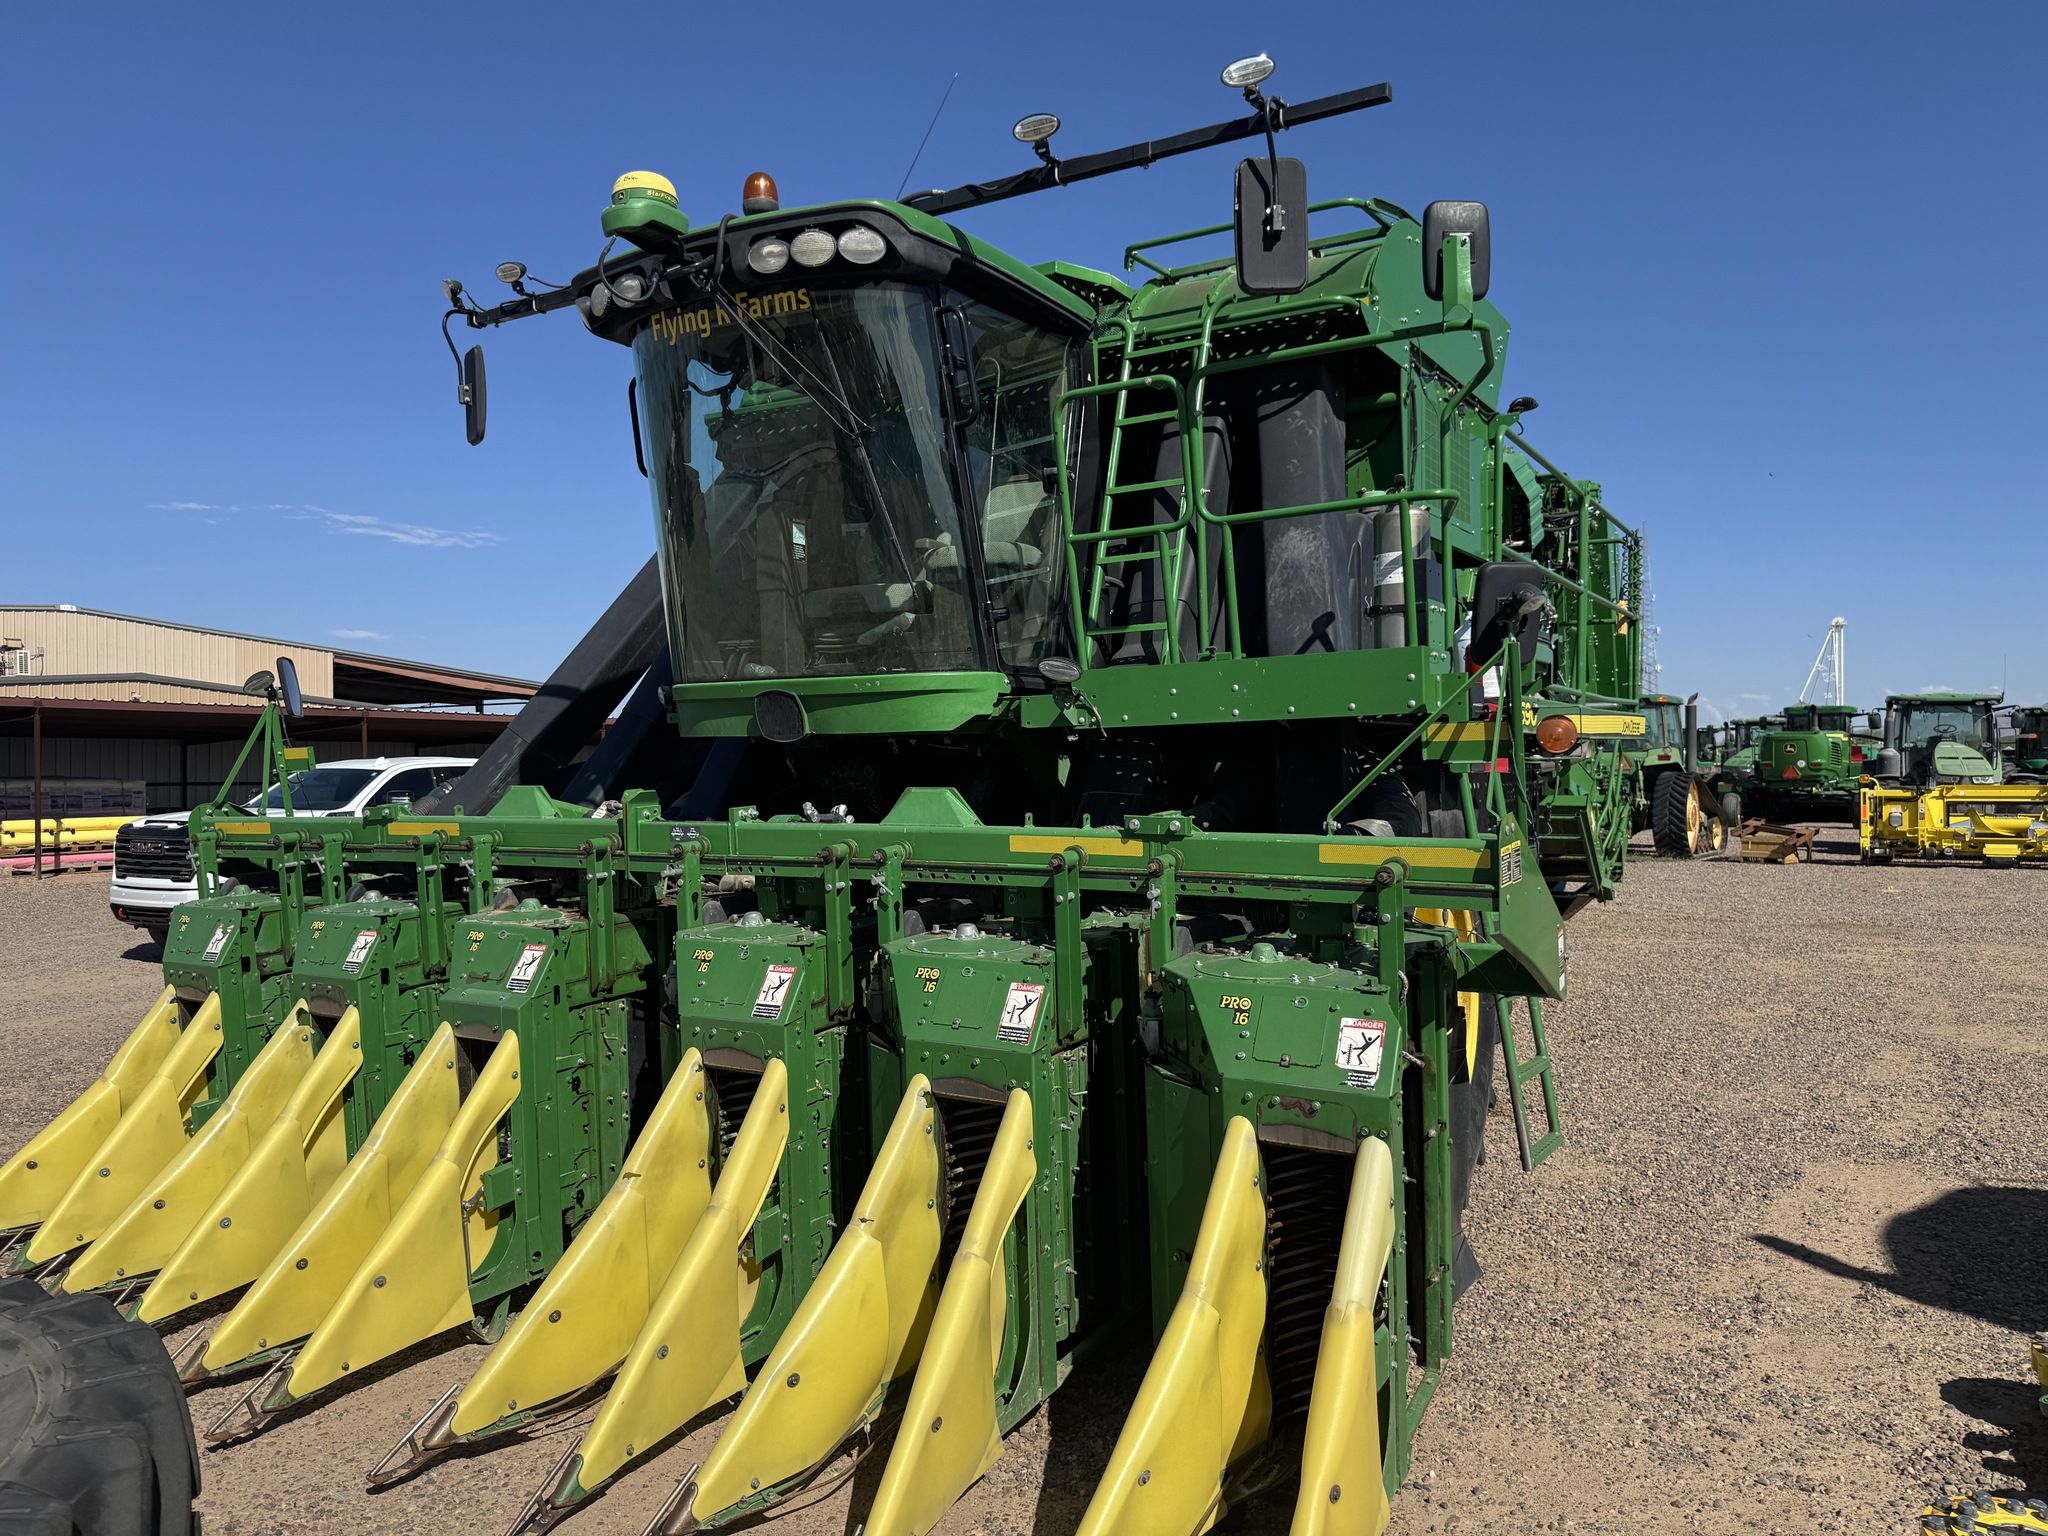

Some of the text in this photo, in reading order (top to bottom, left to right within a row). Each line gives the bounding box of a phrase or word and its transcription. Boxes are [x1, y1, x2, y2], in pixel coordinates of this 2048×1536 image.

[651, 307, 711, 346] Flying
[735, 287, 811, 321] Farms
[131, 842, 154, 853] GMC
[310, 921, 326, 930] PRO
[467, 931, 485, 941] PRO
[469, 942, 480, 951] 16
[692, 949, 714, 960] PRO
[697, 962, 710, 972] 16
[915, 967, 940, 979] PRO
[923, 981, 937, 992] 16
[1219, 995, 1252, 1010] PRO
[1233, 1012, 1249, 1025] 16
[1352, 1020, 1384, 1029] DANGER
